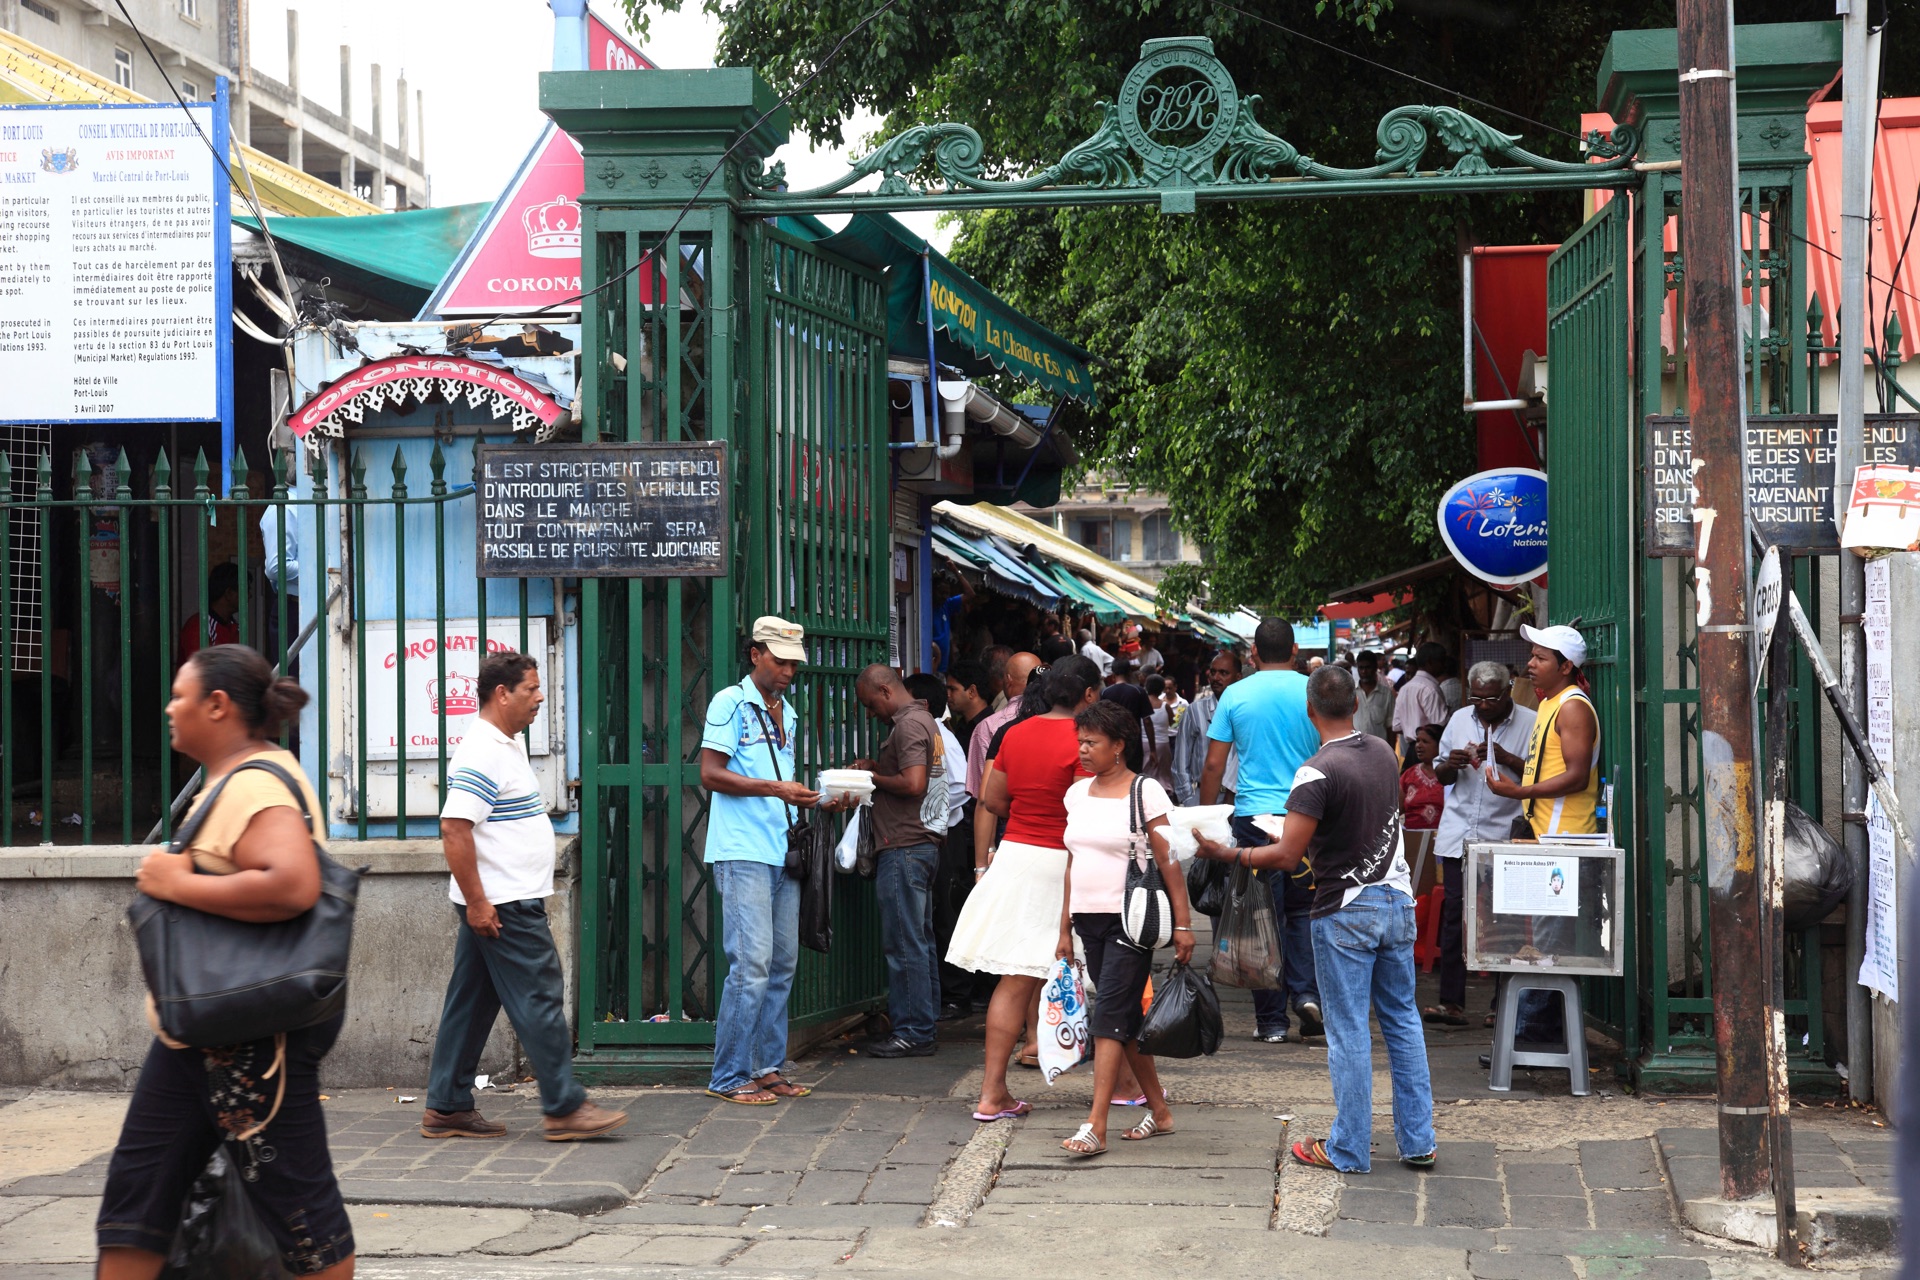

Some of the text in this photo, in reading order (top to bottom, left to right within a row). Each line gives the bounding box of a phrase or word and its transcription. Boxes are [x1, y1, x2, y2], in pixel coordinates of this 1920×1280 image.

[3, 126, 43, 140] PORT LOUIS
[79, 123, 200, 139] CONSEIL MUNICIPAL DE PORT-LOUIS
[106, 150, 175, 160] AVIS IMPORTANT
[5, 172, 36, 183] MARKET
[93, 170, 189, 182] Marché Central de Port-Louis
[12, 196, 49, 206] particular
[93, 195, 124, 203] conseillé
[128, 195, 139, 203] aux
[176, 194, 183, 202] du
[187, 194, 210, 203] public,
[17, 209, 49, 217] visitors,
[84, 208, 123, 217] particulier
[72, 220, 106, 228] Visiteurs
[110, 219, 149, 229] étrangers,
[152, 219, 161, 227] de
[192, 218, 210, 226] avoir
[16, 233, 50, 242] shopping
[113, 231, 139, 239] services
[197, 231, 210, 239] pour
[73, 244, 90, 252] leurs
[93, 244, 115, 252] achats
[130, 243, 156, 251] marché.
[17, 263, 50, 272] by them
[73, 262, 91, 270] Tout
[126, 261, 177, 269] harcèlement
[181, 261, 195, 270] par
[198, 260, 212, 268] des
[73, 271, 212, 282] intermédiaires doit être rapporté
[74, 285, 135, 294] immédiatement
[152, 285, 173, 294] poste
[189, 284, 212, 294] police
[487, 276, 581, 293] CORONA
[6, 288, 23, 296] spot.
[74, 298, 82, 306] se
[146, 297, 158, 305] les
[163, 296, 186, 304] lieux.
[1, 319, 41, 328] prosecuted
[73, 318, 86, 326] Ces
[152, 316, 193, 326] pourraient
[197, 315, 212, 324] être
[32, 331, 51, 339] Louis
[74, 330, 109, 339] passibles
[124, 329, 160, 338] poursuite
[164, 328, 200, 338] judiciaire
[986, 320, 1000, 349] La
[74, 342, 93, 350] vertu
[109, 341, 115, 349] la
[119, 341, 146, 349] section
[193, 340, 212, 348] Louis
[74, 352, 197, 364] (Municipal Market) Regulations 1993.
[74, 377, 91, 385] Hôtel
[103, 376, 118, 384] Ville
[74, 389, 108, 397] Port-Louis
[303, 360, 546, 425] CORONATION
[75, 405, 78, 413] 3
[1655, 429, 1823, 446] IL ES CTEMENT
[1767, 449, 1799, 464] DES
[485, 461, 720, 478] IL EST STRICTEMENT DEFENDU
[485, 481, 720, 498] D'INTRODUIRE DES VEHICULES
[1750, 487, 1829, 502] RAVENANT
[485, 504, 525, 518] DANS
[538, 503, 557, 518] LE
[1656, 508, 1695, 523] SIBL
[485, 521, 706, 539] TOUT CONTRAVENANT SERA
[1479, 516, 1548, 537] Loteri
[1513, 539, 1547, 547] Nationa
[485, 542, 720, 558] PASSIBLE DE POURSUITE JUDICIAIRE
[411, 735, 463, 746] Chace
